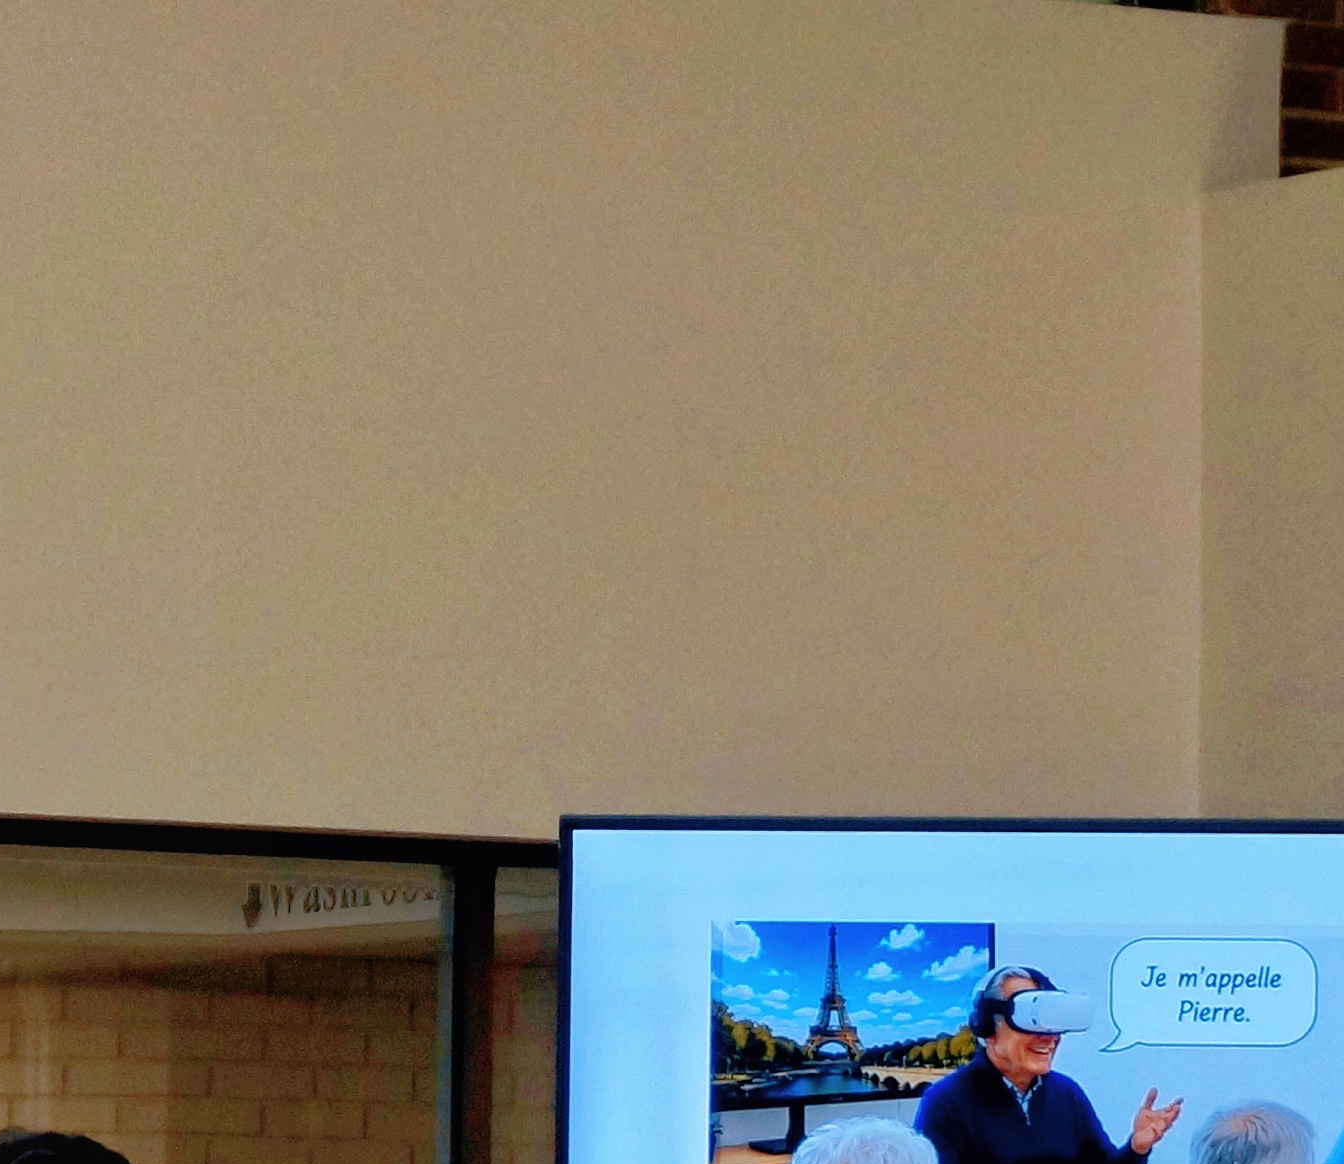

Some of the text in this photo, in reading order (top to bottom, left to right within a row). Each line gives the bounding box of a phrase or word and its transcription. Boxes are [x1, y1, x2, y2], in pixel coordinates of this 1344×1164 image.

[1140, 965, 1282, 995] Je m'appelle
[1178, 1000, 1250, 1022] Pierre.
